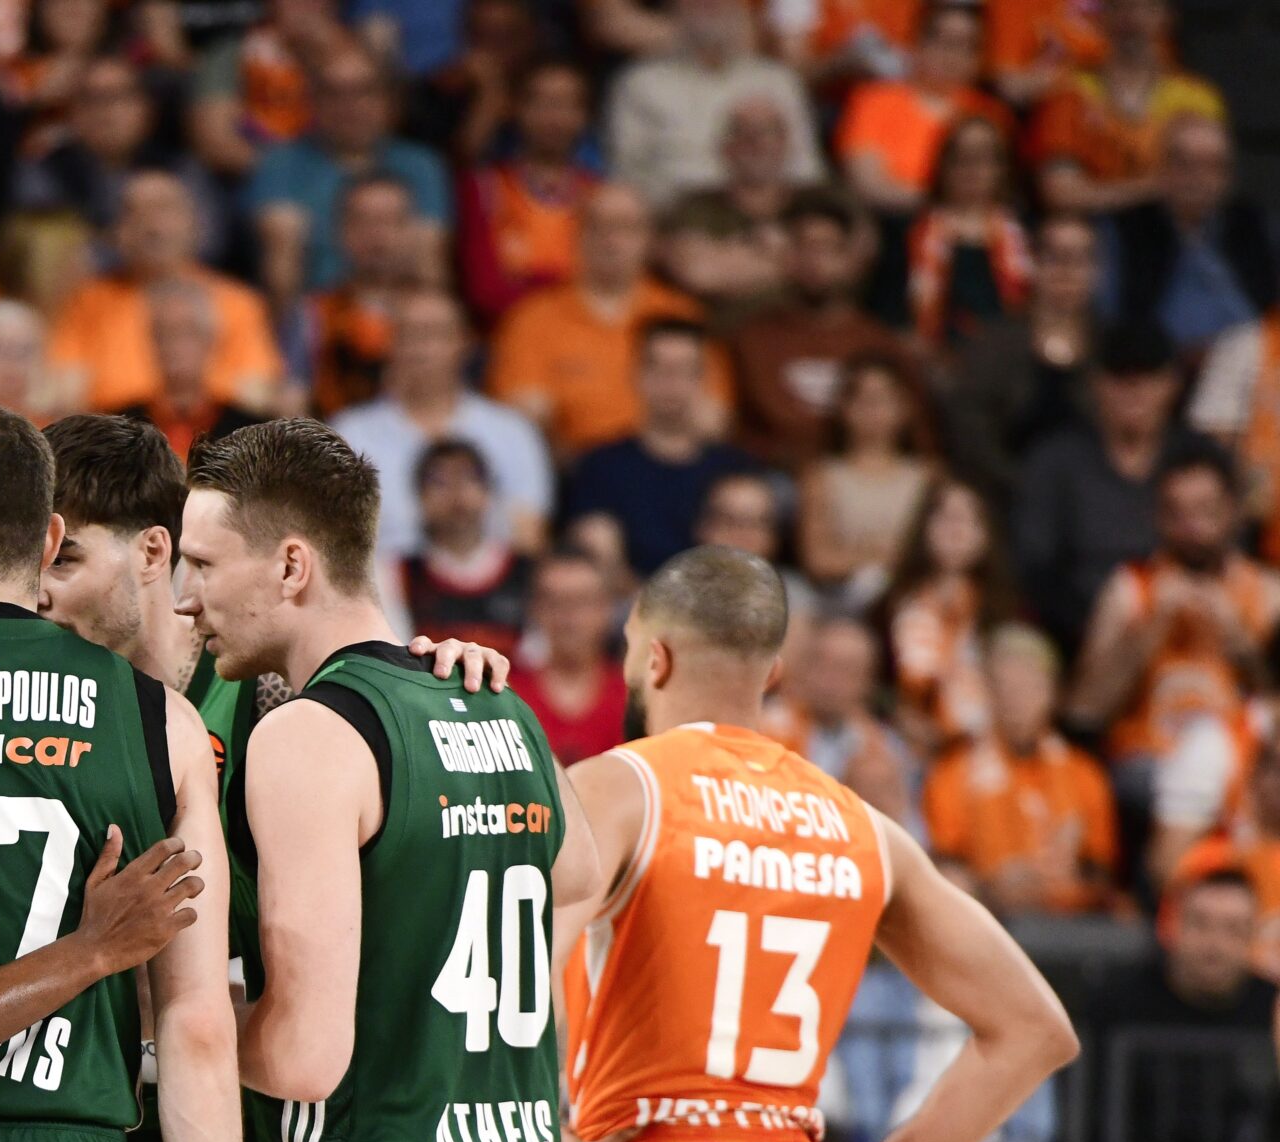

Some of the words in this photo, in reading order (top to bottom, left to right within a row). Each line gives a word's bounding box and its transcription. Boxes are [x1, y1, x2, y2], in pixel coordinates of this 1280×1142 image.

[428, 718, 534, 774] GRIGONIS
[438, 794, 551, 839] instacar
[691, 773, 851, 843] THOMPSON
[693, 835, 863, 901] PAMESA
[430, 864, 551, 1053] 40
[705, 909, 832, 1087] 13
